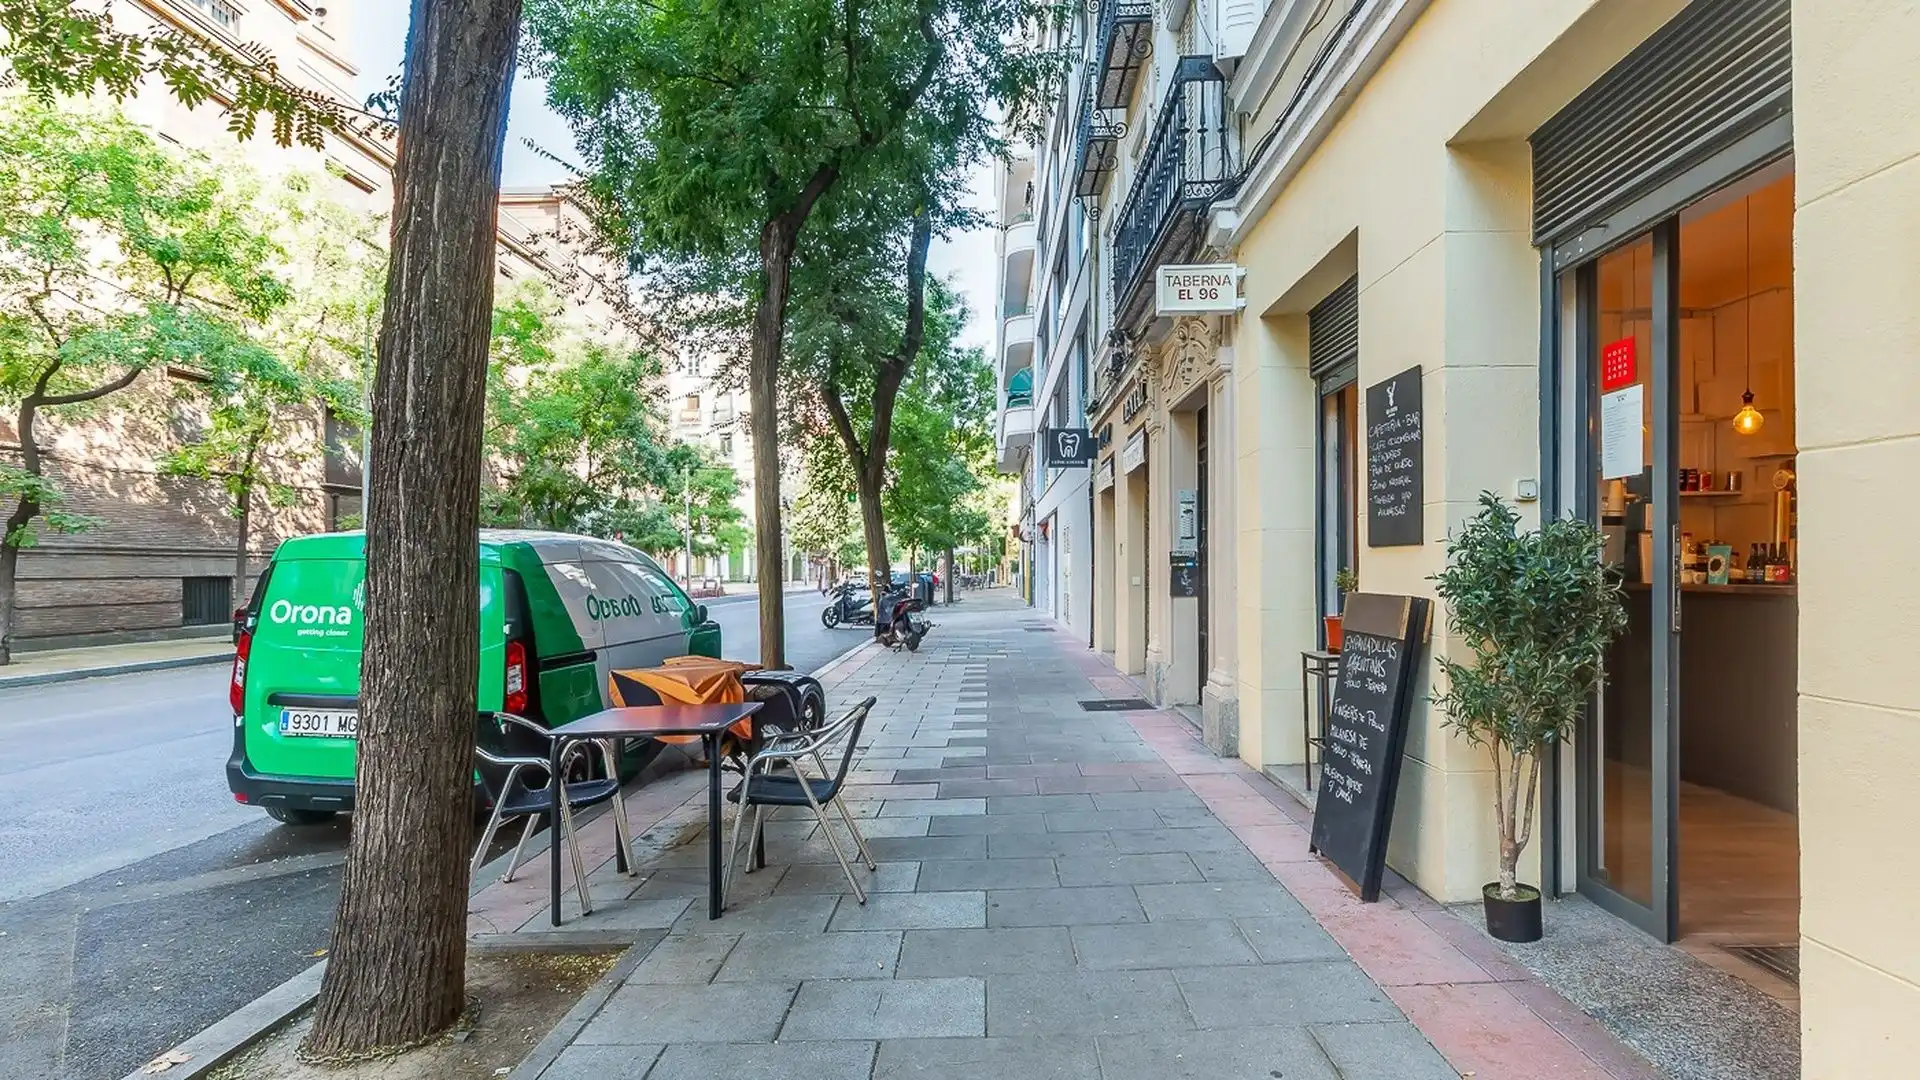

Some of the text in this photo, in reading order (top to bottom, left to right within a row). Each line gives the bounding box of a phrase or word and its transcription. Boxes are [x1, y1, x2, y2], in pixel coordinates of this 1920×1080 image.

[1165, 274, 1232, 287] TABERNA
[1178, 287, 1219, 300] EL 96
[270, 599, 352, 625] Orona
[292, 714, 358, 733] 9301 MG
